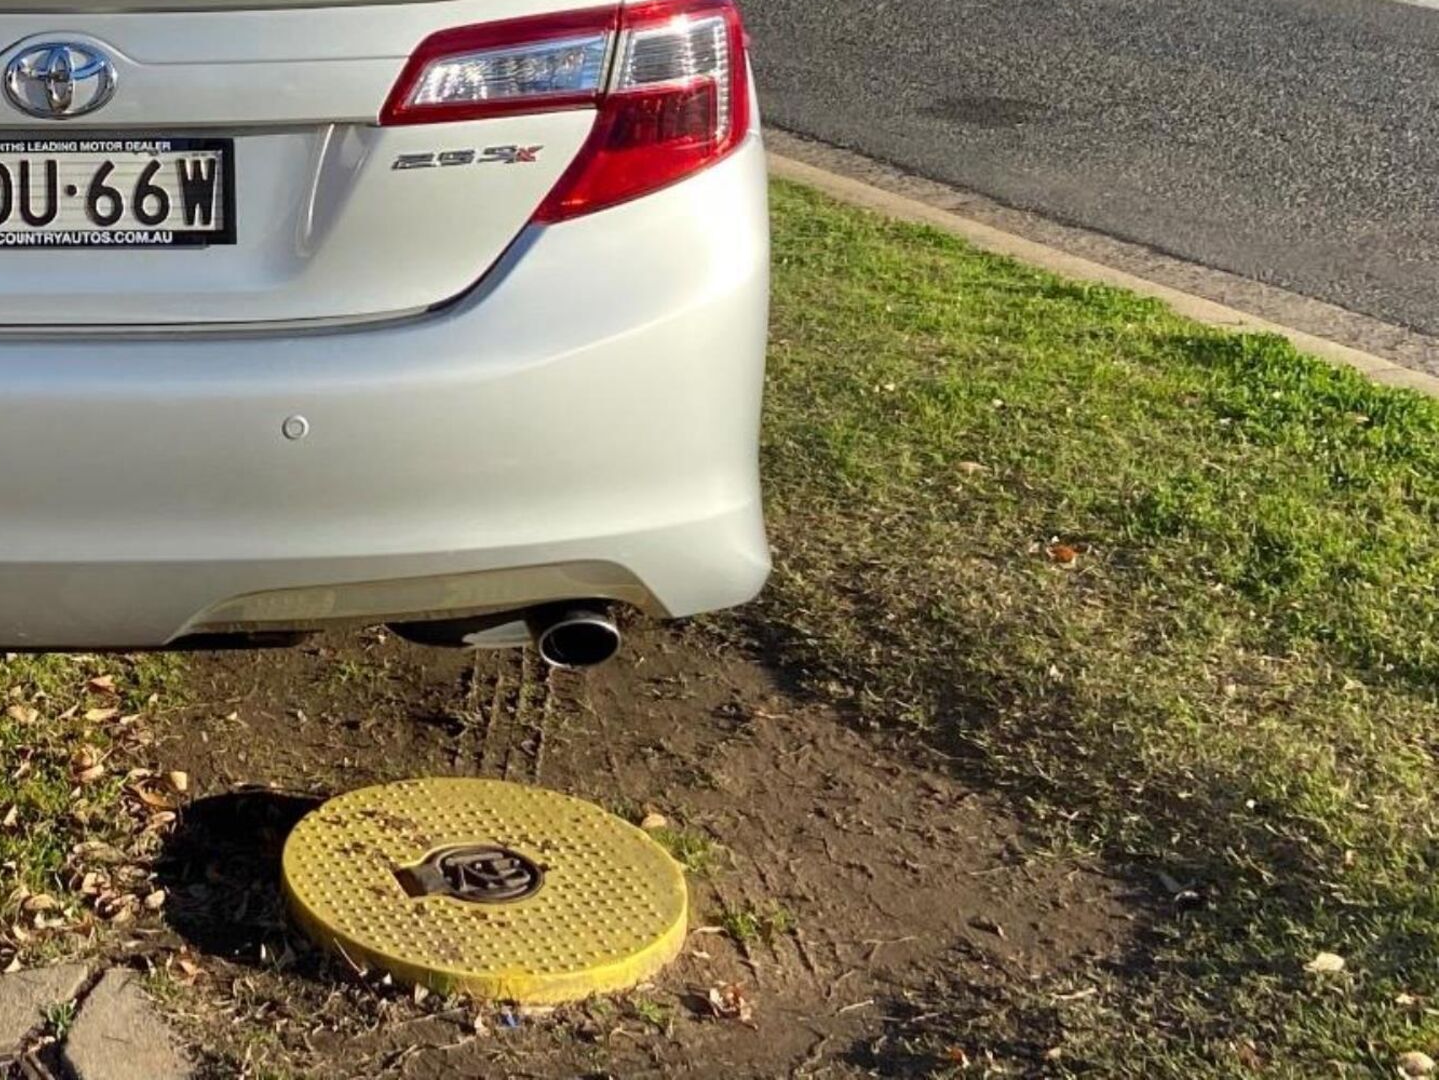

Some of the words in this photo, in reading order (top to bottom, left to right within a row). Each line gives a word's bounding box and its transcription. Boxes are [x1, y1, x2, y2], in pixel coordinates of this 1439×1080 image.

[27, 141, 78, 153] LEADING
[80, 141, 123, 152] MOTOR
[125, 141, 171, 152] DEALER
